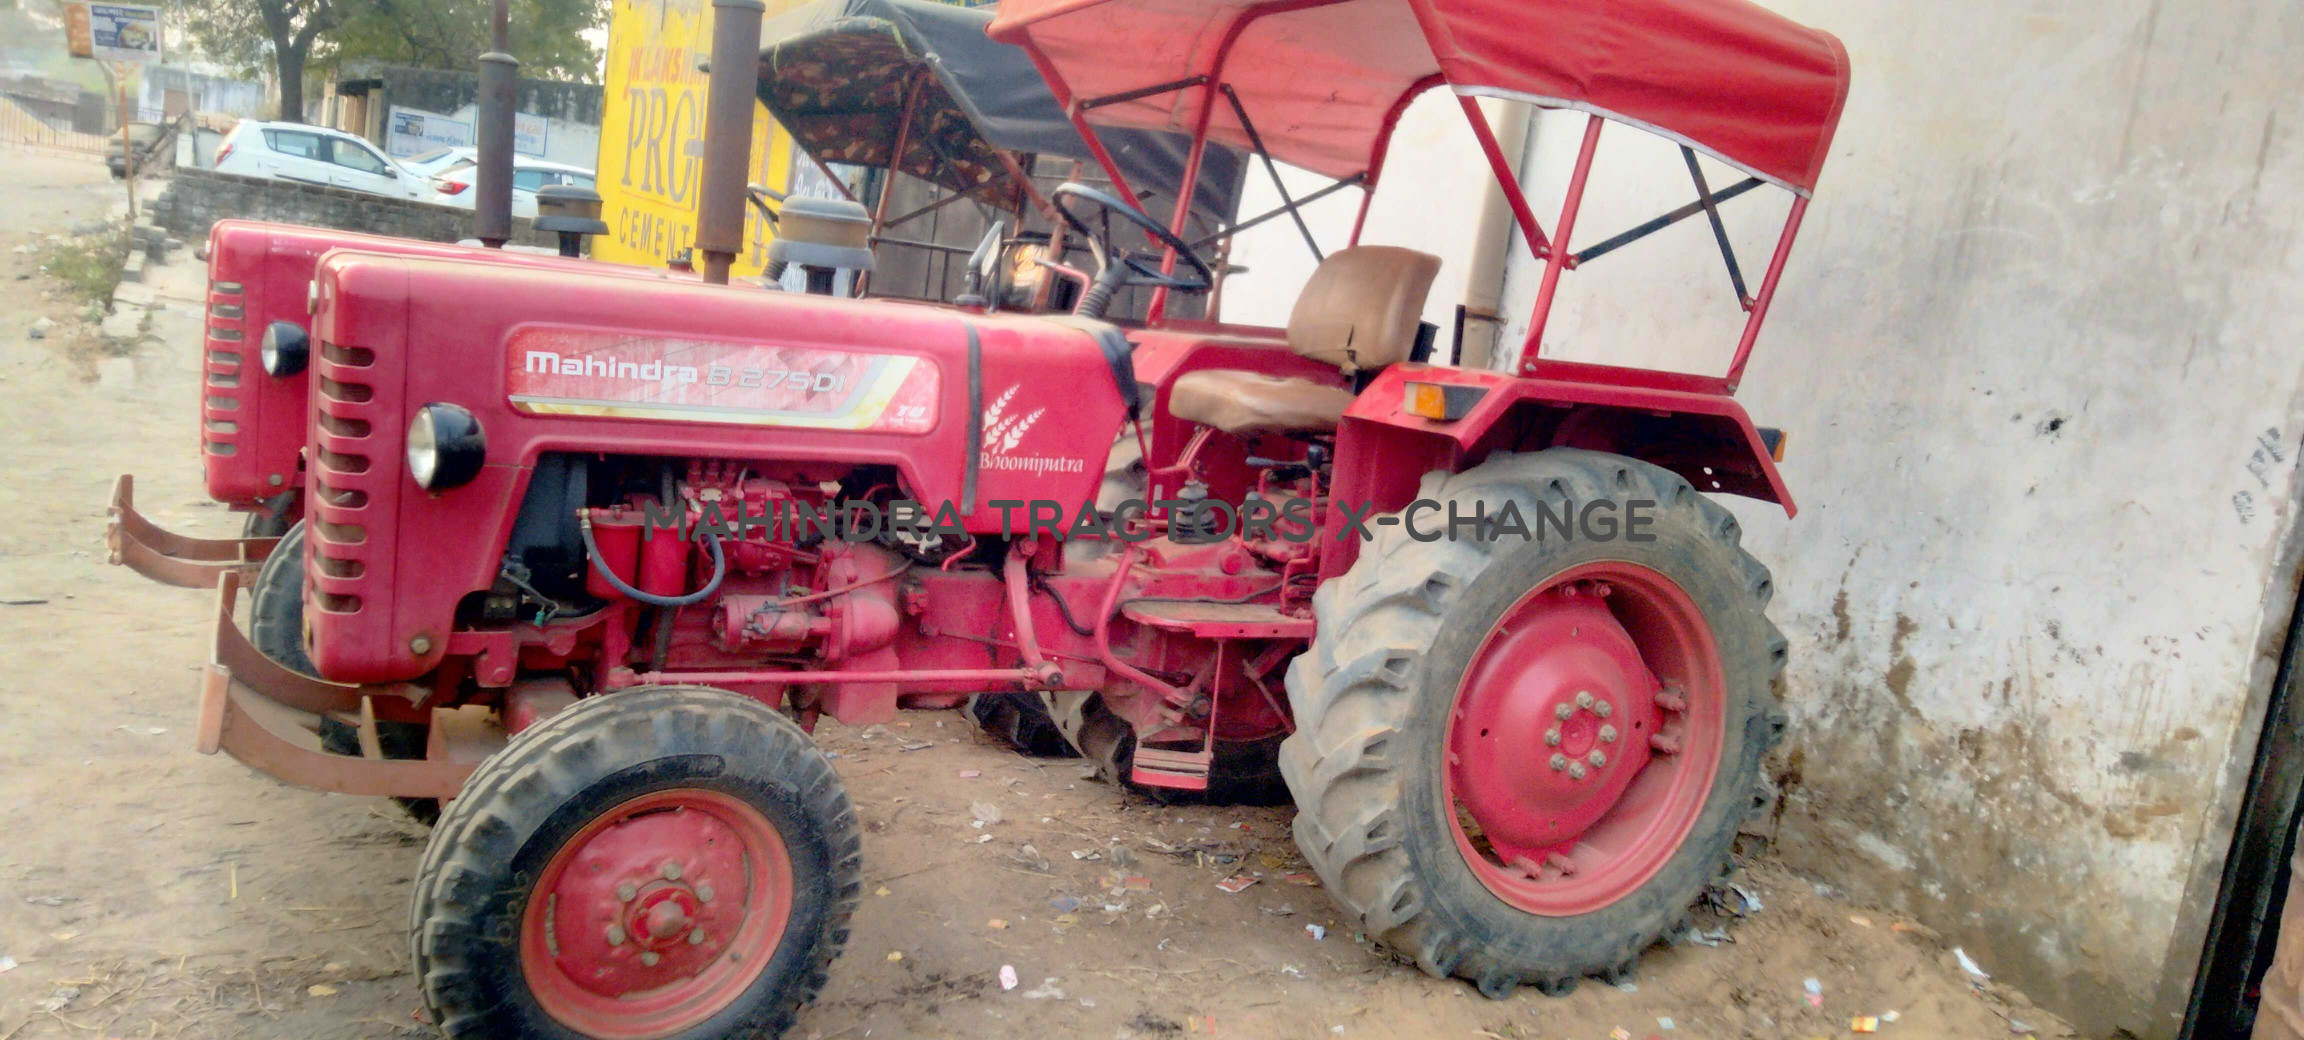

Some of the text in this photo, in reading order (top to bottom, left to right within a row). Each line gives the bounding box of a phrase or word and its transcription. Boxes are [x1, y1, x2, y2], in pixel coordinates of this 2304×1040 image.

[619, 206, 690, 261] CEMENT
[526, 350, 846, 393] Mahindra B 275DI
